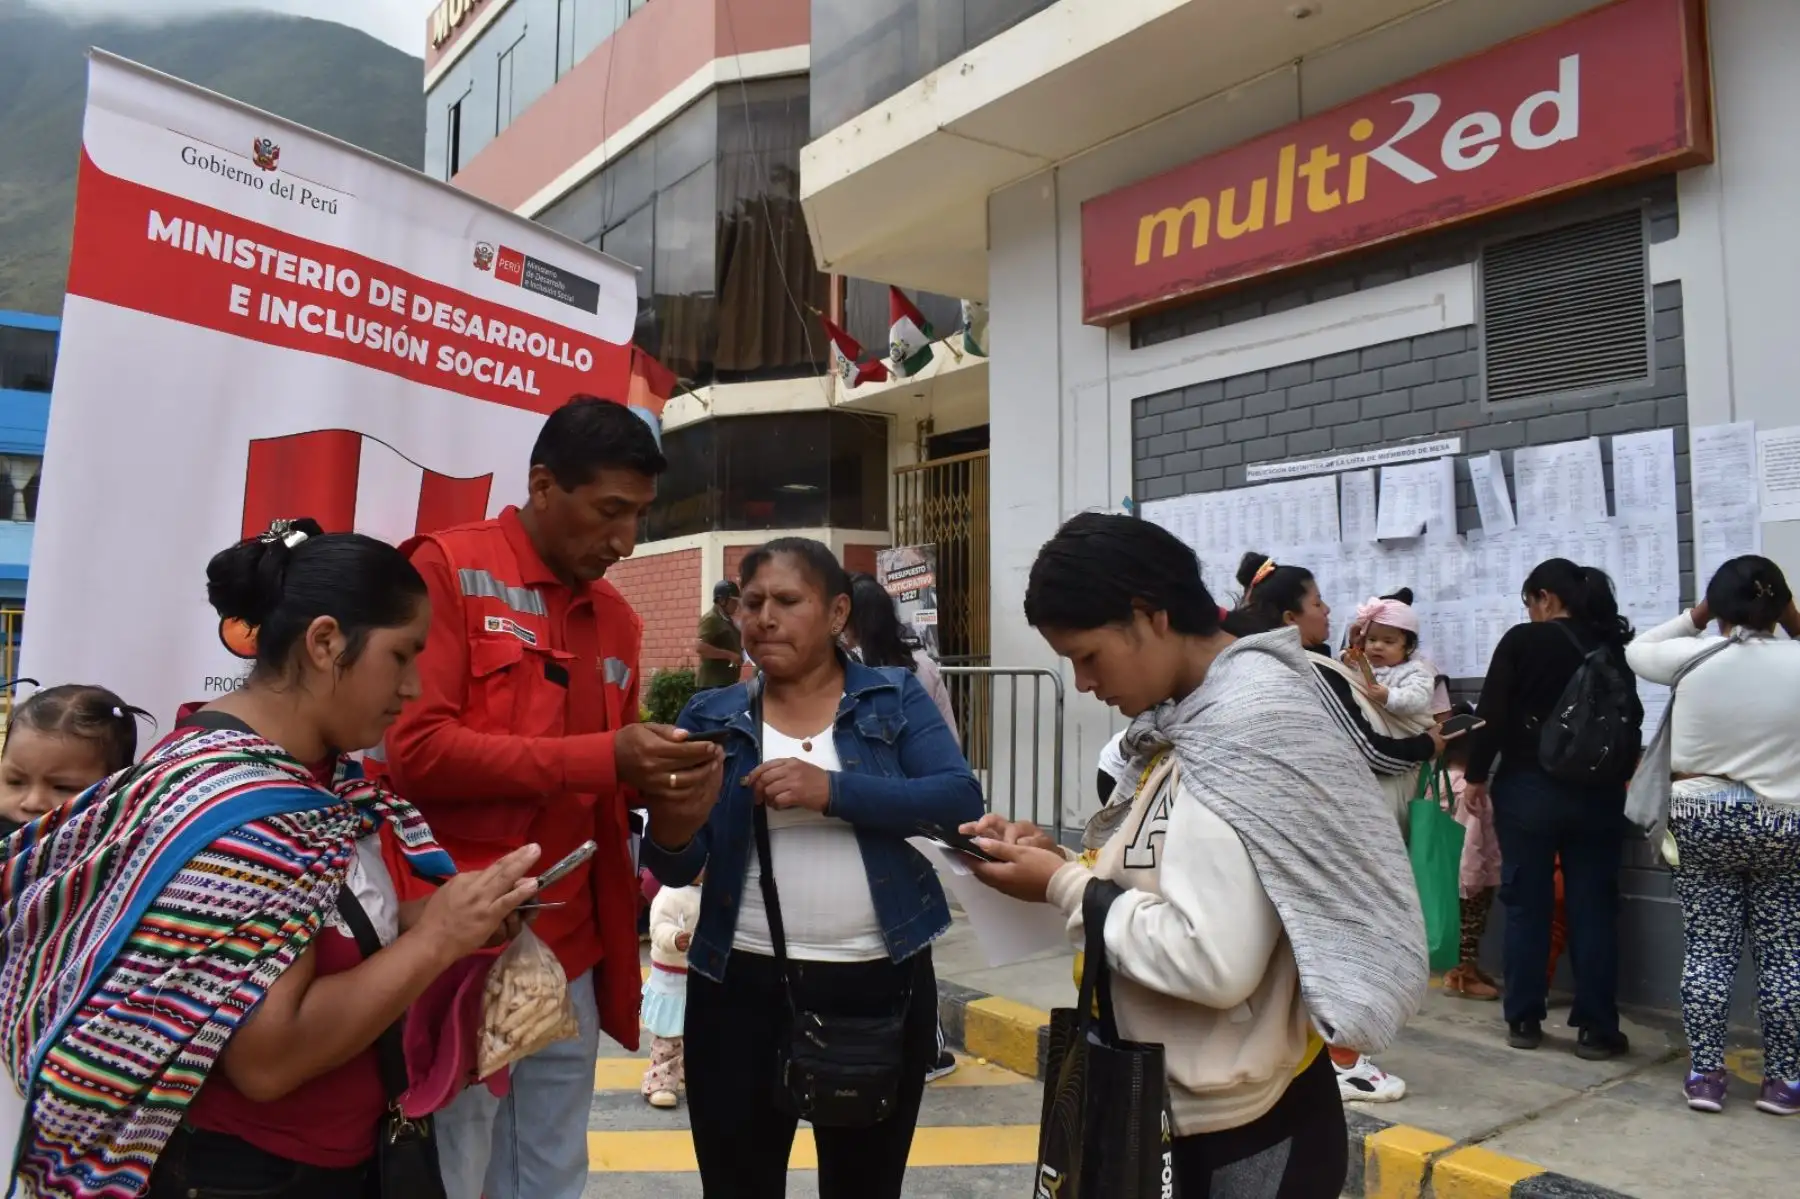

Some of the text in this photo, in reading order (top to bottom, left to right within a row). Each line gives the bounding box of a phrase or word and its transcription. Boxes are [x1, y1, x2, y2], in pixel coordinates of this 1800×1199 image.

[432, 0, 475, 48] MU
[1134, 54, 1580, 266] multiRed
[181, 146, 338, 215] Gobierno del Perú
[499, 259, 521, 273] PERÚ
[525, 270, 566, 290] de Desarrollo
[526, 260, 558, 278] Ministerio
[147, 209, 593, 372] MINISTERIO DE DESARROLLO
[229, 283, 541, 396] E INCLUSIÓN SOCIAL
[1378, 449, 1417, 460] MIEMBROS
[1418, 447, 1429, 455] DE
[1429, 443, 1450, 453] MESA
[887, 565, 926, 581] PRESUPUESTO
